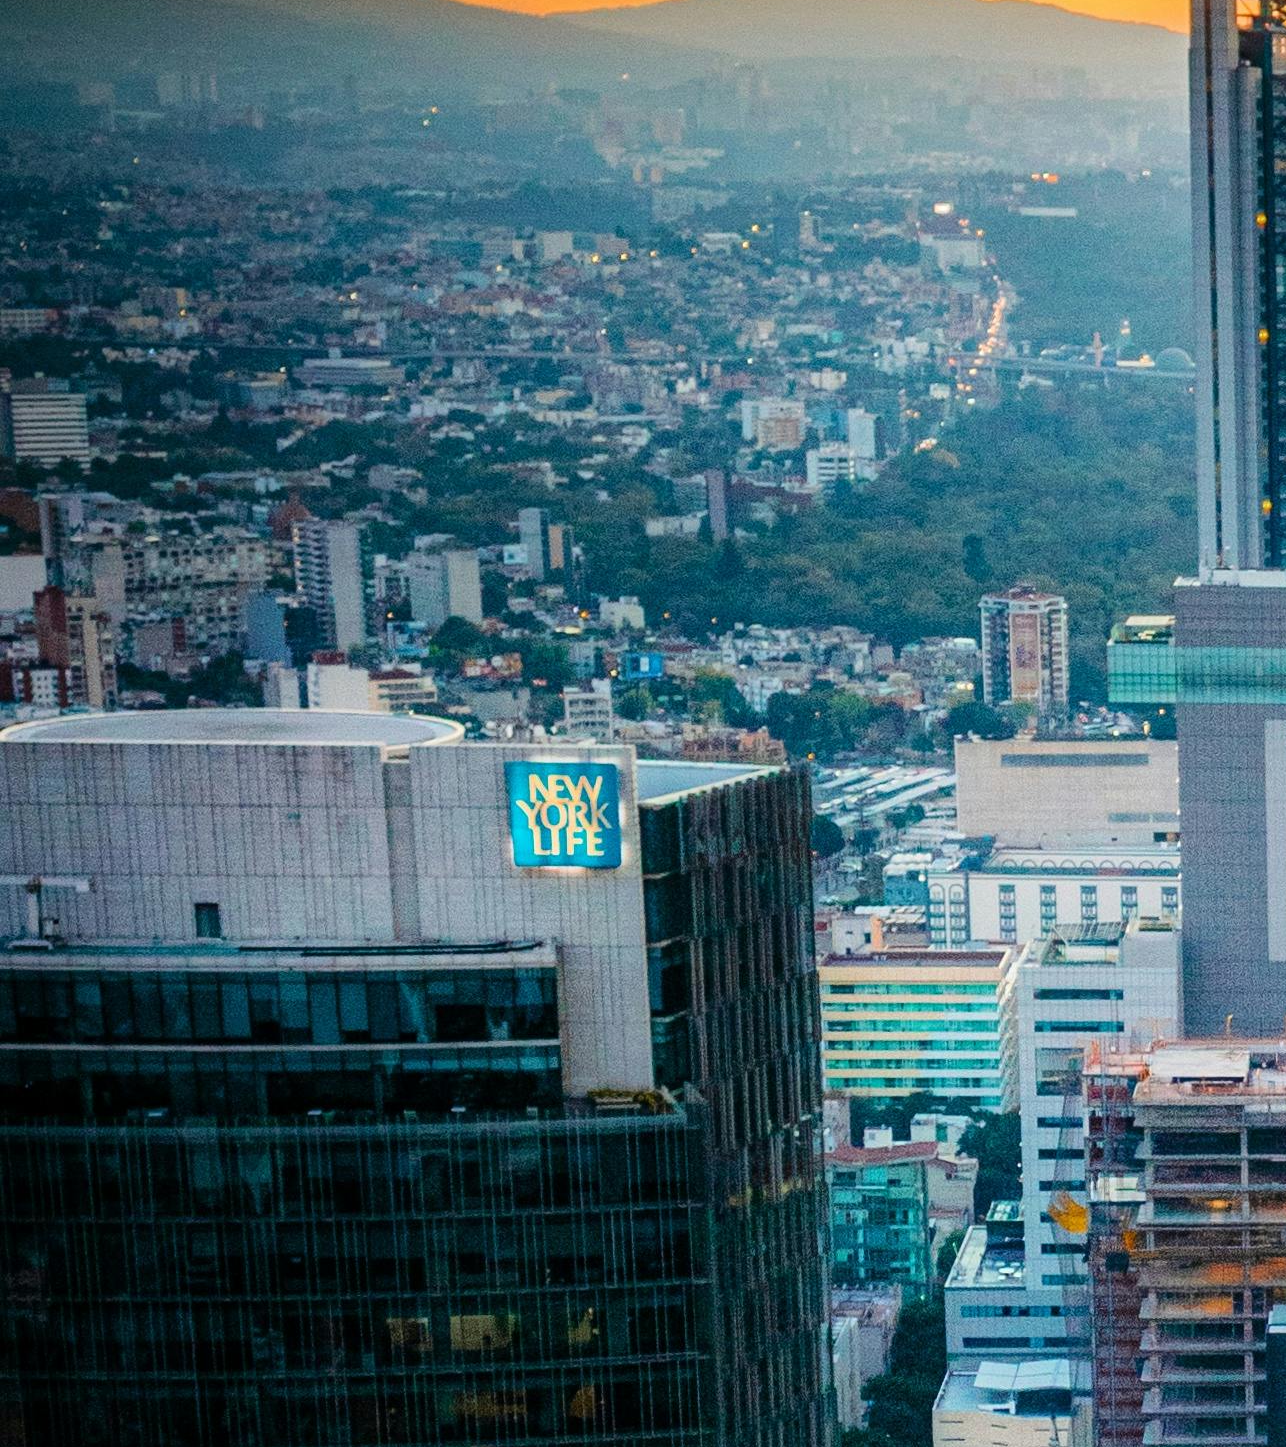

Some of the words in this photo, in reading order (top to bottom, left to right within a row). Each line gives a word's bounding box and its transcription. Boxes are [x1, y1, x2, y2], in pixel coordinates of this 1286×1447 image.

[528, 773, 604, 803] NEW
[515, 799, 613, 830] YORK
[530, 825, 605, 857] LIFE
